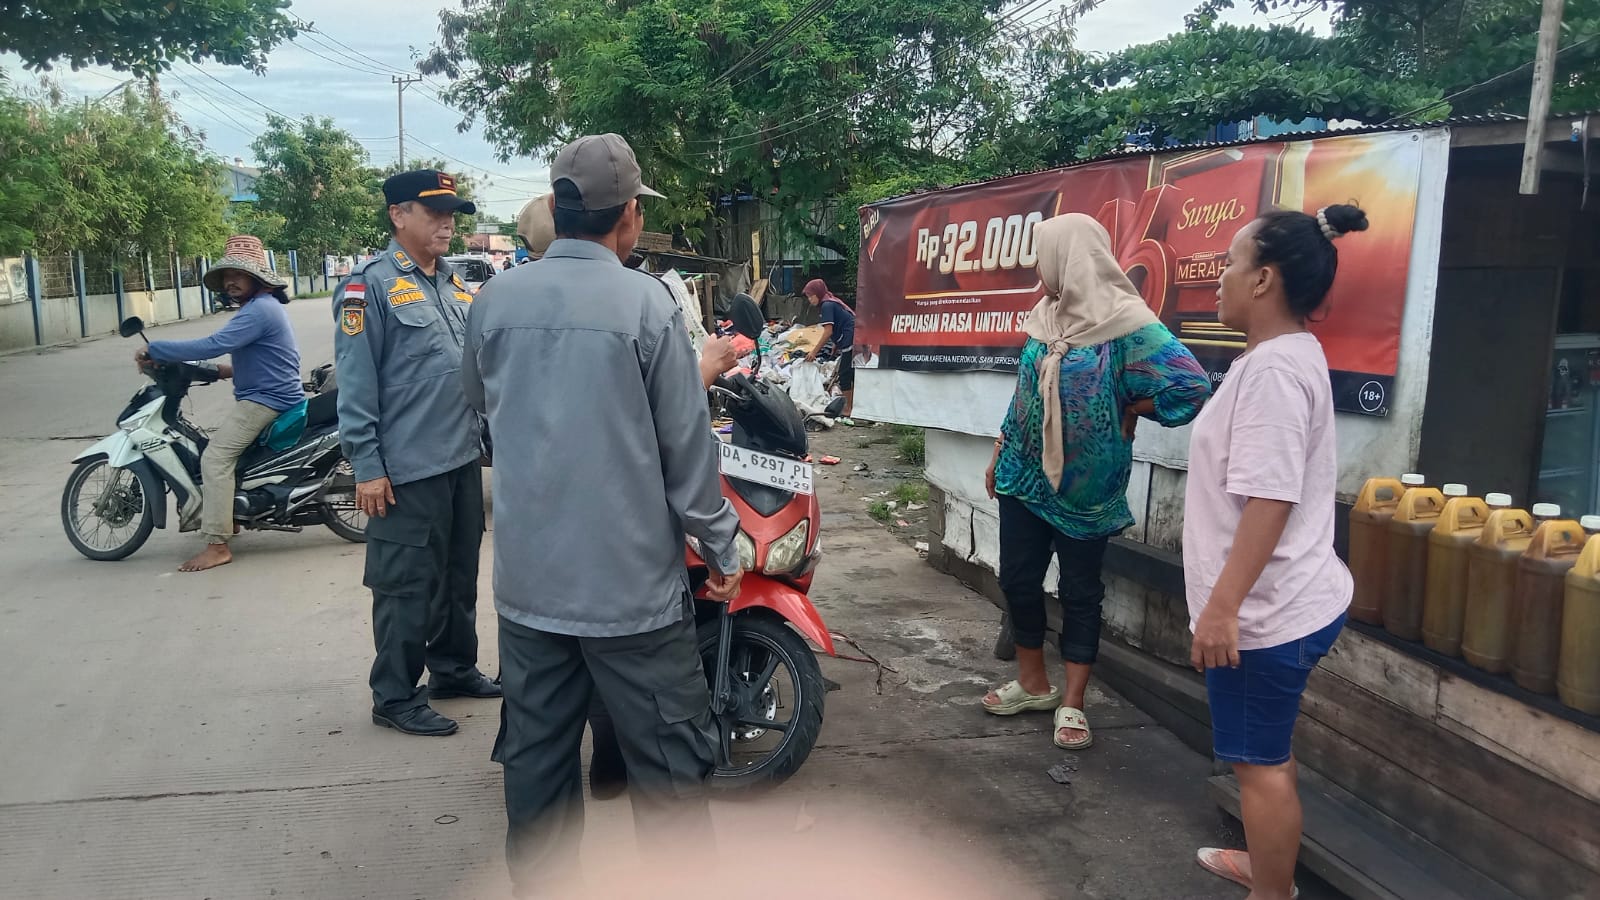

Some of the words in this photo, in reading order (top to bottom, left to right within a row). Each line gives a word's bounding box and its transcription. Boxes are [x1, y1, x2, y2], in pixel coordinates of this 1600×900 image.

[1176, 198, 1246, 239] Surya
[890, 314, 939, 333] KEPUASAN
[940, 312, 972, 333] RASA
[974, 311, 1014, 333] UNTUK
[1363, 390, 1381, 401] 18+
[722, 445, 741, 462] DA
[750, 453, 785, 473] 6297
[793, 464, 810, 480] PL
